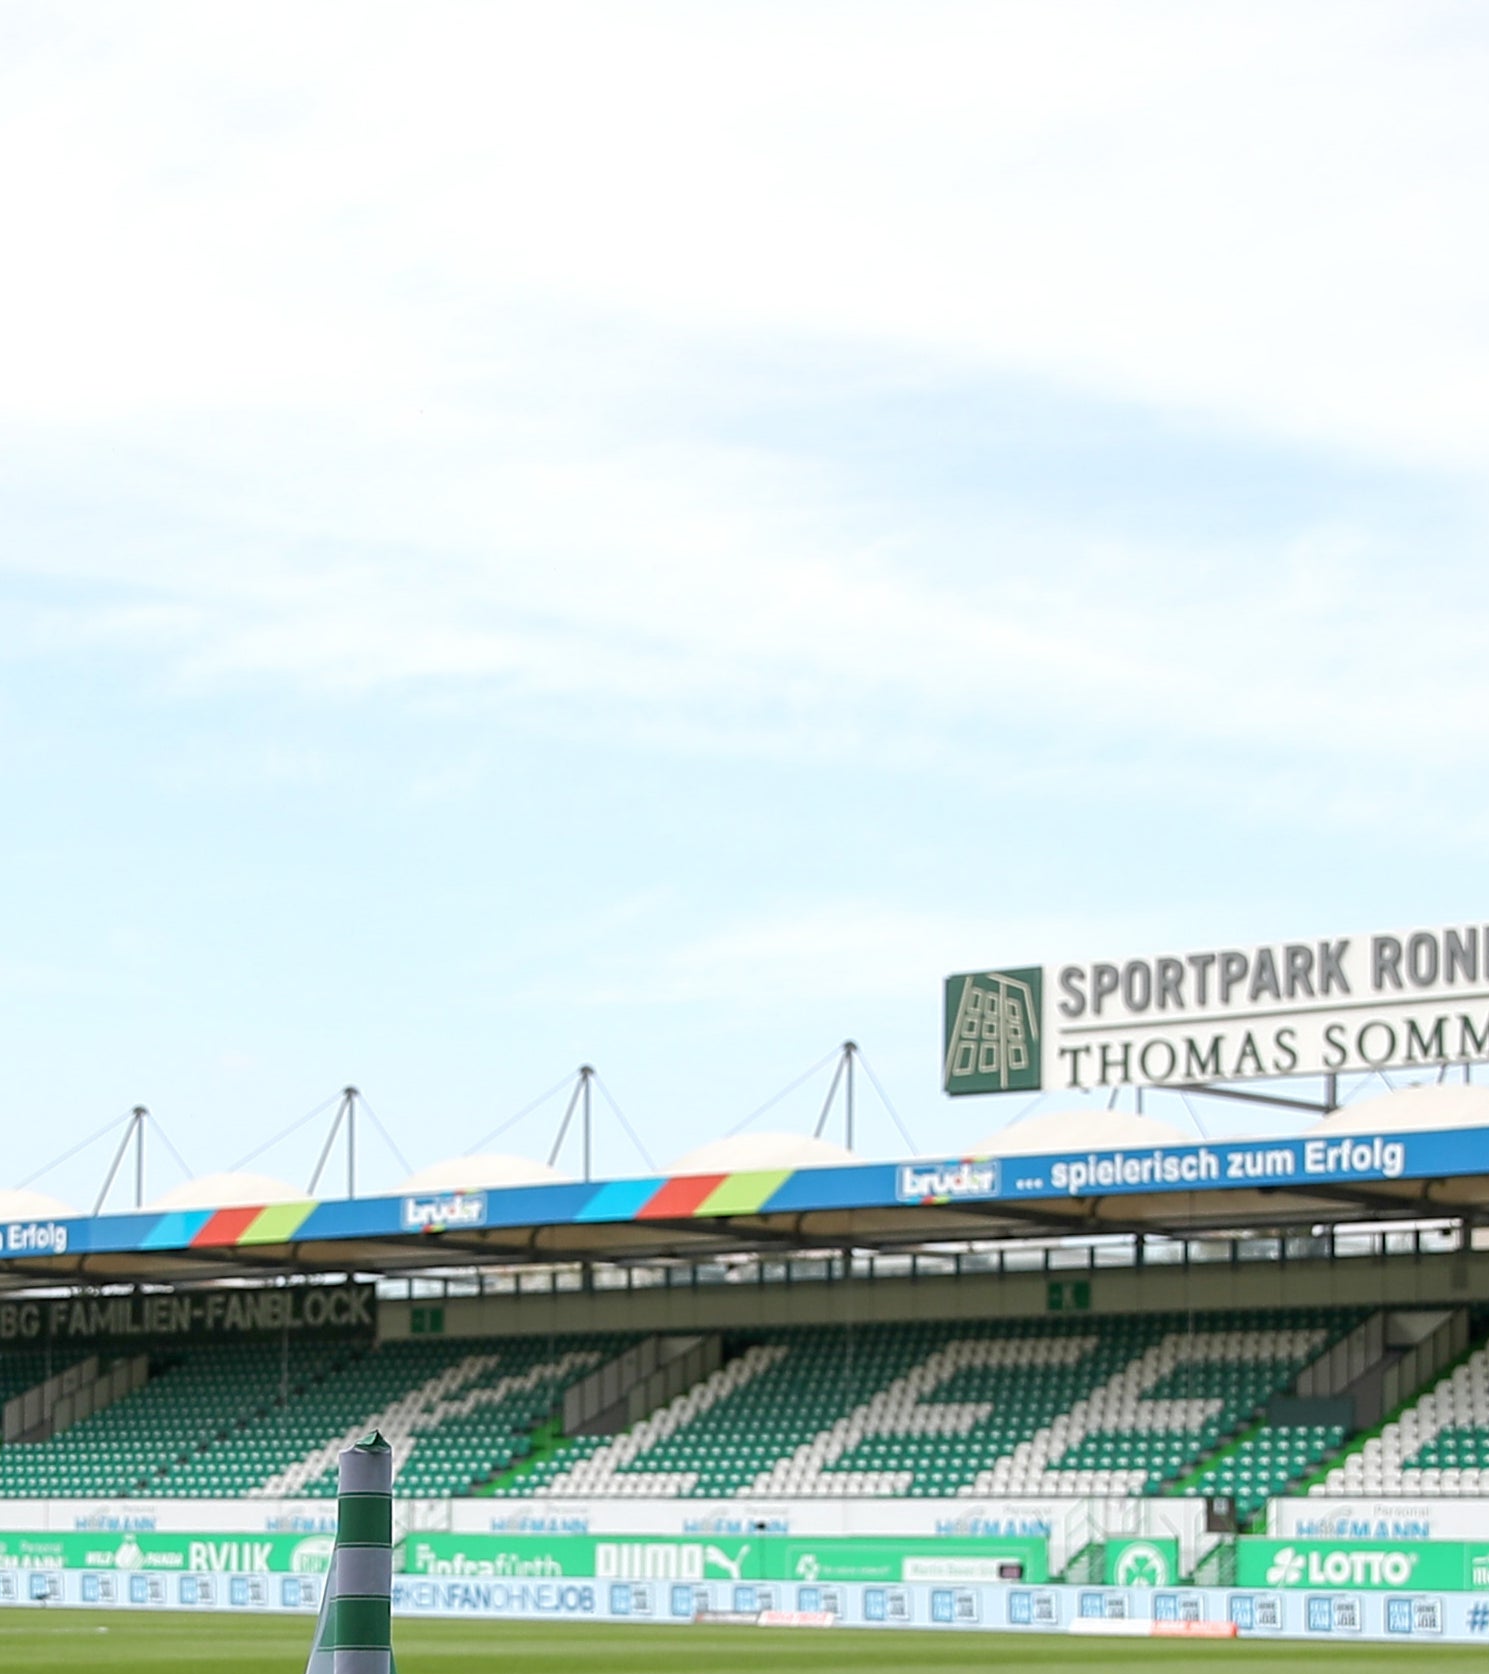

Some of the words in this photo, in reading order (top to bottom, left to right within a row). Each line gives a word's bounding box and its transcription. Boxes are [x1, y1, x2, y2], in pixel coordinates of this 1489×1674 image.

[1058, 939, 1352, 1018] SPORTPARK
[1058, 1028, 1299, 1087] THOMAS
[902, 1165, 994, 1198] bruder
[1051, 1149, 1217, 1193] spielerisch
[1227, 1151, 1294, 1179] zum
[1304, 1138, 1405, 1177] Erfolg
[405, 1194, 482, 1225] bruder
[7, 1223, 68, 1253] Erfolg
[1308, 1551, 1412, 1585] LOTTO
